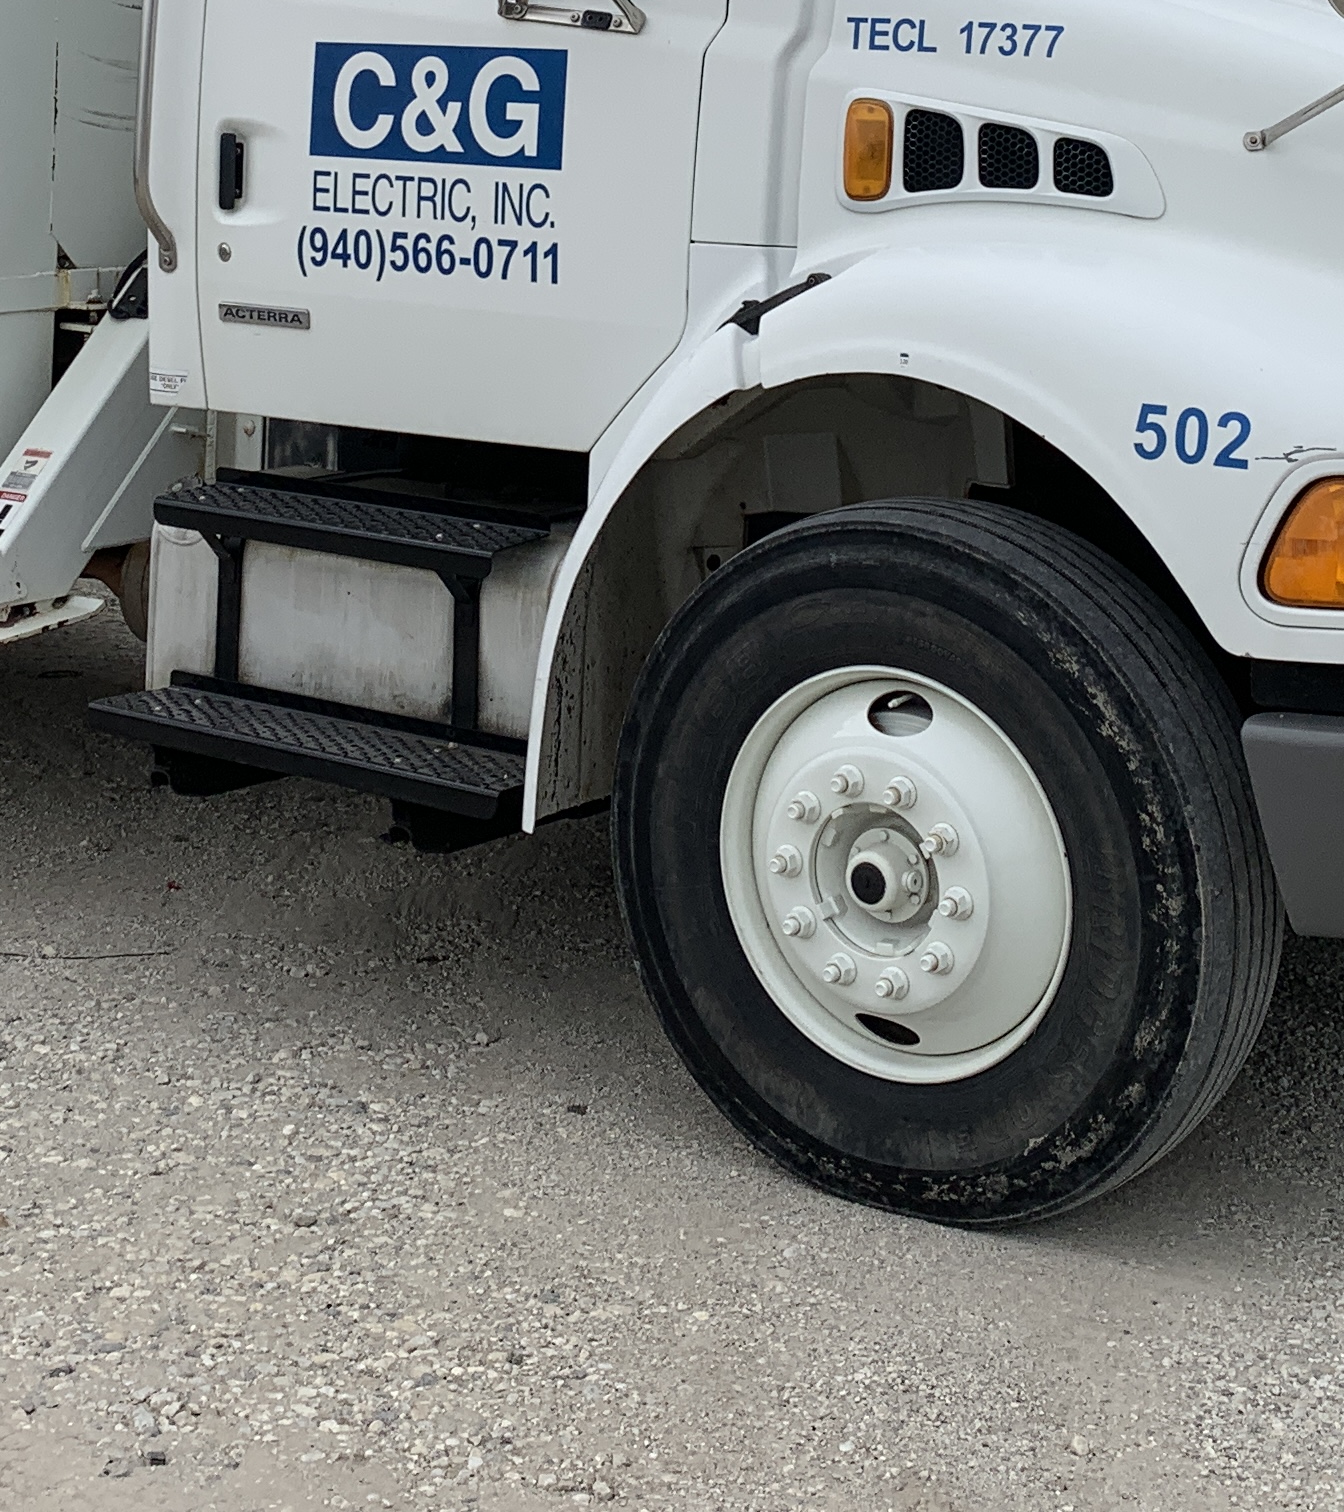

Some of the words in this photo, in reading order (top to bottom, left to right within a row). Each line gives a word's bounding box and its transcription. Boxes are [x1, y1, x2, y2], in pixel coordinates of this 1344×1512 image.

[846, 16, 938, 53] TECL
[959, 20, 1065, 58] 17377
[333, 50, 541, 158] C&G
[312, 170, 477, 231] ELECTRIC,
[494, 181, 555, 229] INC.
[297, 225, 559, 285] (940)566-0711
[223, 307, 303, 325] ACTERRA
[1133, 403, 1252, 470] 502
[1, 492, 26, 501] DANGER
